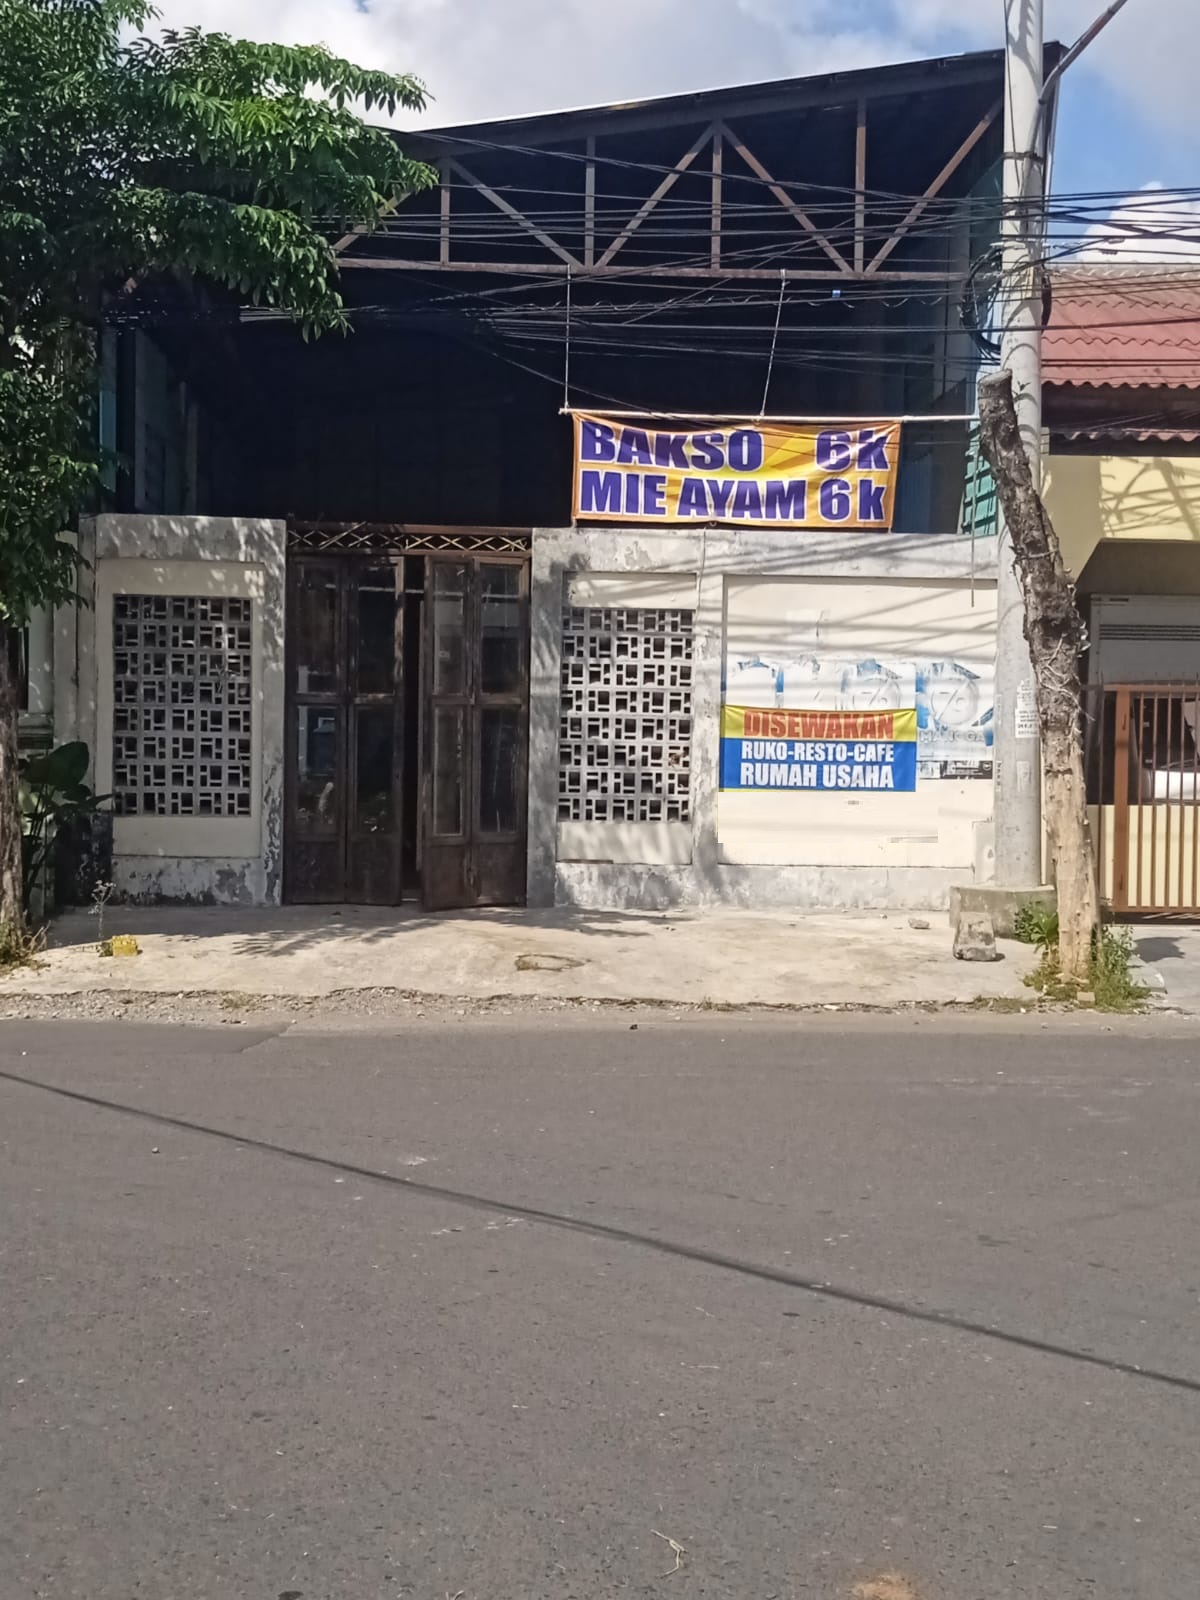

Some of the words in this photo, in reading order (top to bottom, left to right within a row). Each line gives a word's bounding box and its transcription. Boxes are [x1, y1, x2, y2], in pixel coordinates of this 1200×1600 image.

[579, 421, 763, 471] BAKSO
[579, 470, 668, 516] MIE
[677, 478, 807, 520] AYAM
[743, 710, 894, 739] DISEWAKAN
[741, 740, 894, 763] RUKO-RESTO-CAFE
[740, 762, 817, 787] RUMAH
[822, 764, 894, 788] USAHA
